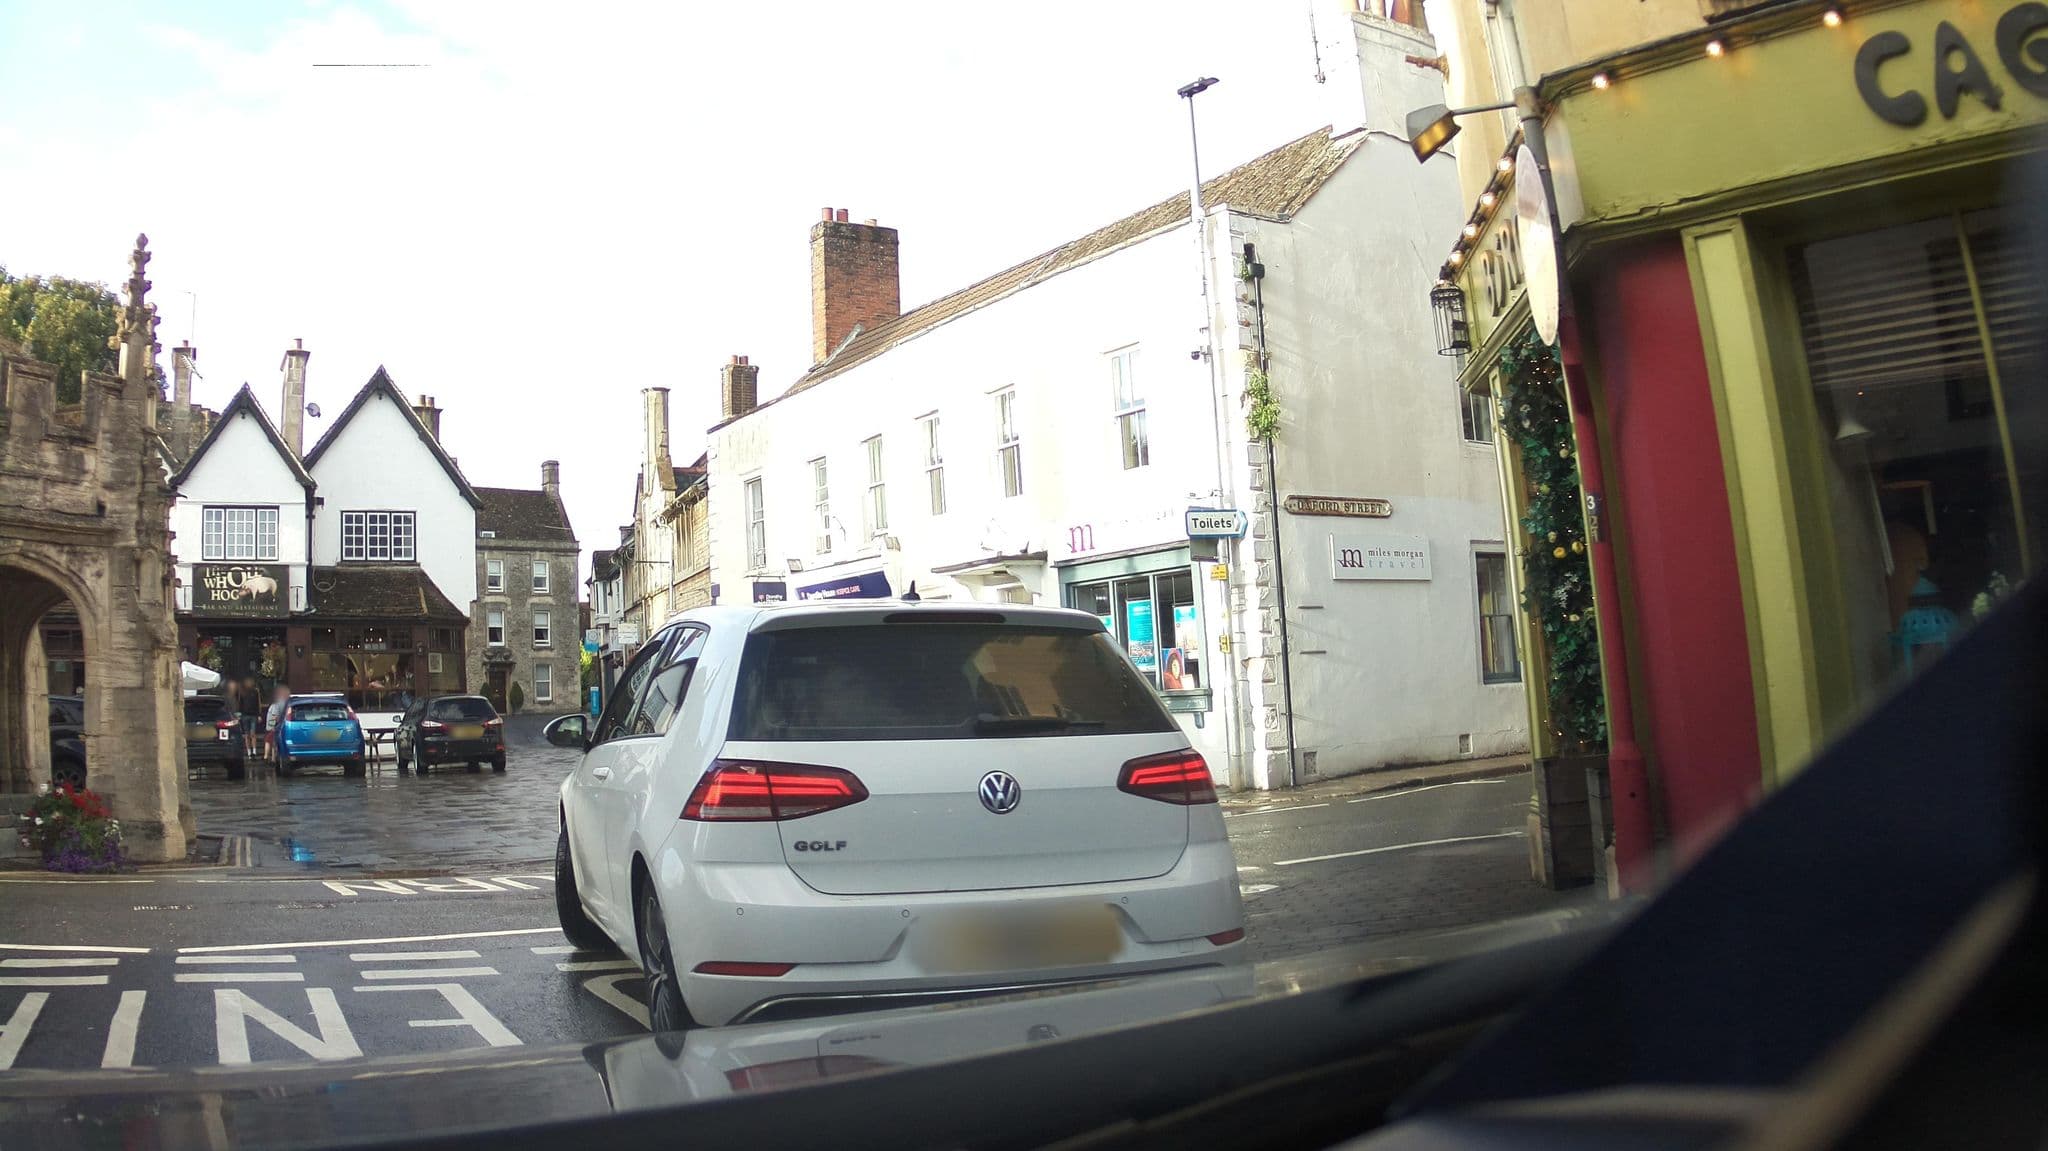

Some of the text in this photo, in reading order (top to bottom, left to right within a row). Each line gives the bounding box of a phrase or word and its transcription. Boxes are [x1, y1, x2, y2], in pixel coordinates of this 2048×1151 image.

[1297, 501, 1384, 514] OXFORD STREET
[1587, 495, 1596, 510] 3
[1191, 517, 1232, 529] Toilets
[1368, 547, 1424, 560] miles morgan
[1368, 559, 1425, 569] travel
[211, 589, 240, 601] HOG
[794, 840, 848, 852] GOLF
[322, 874, 557, 896] URN
